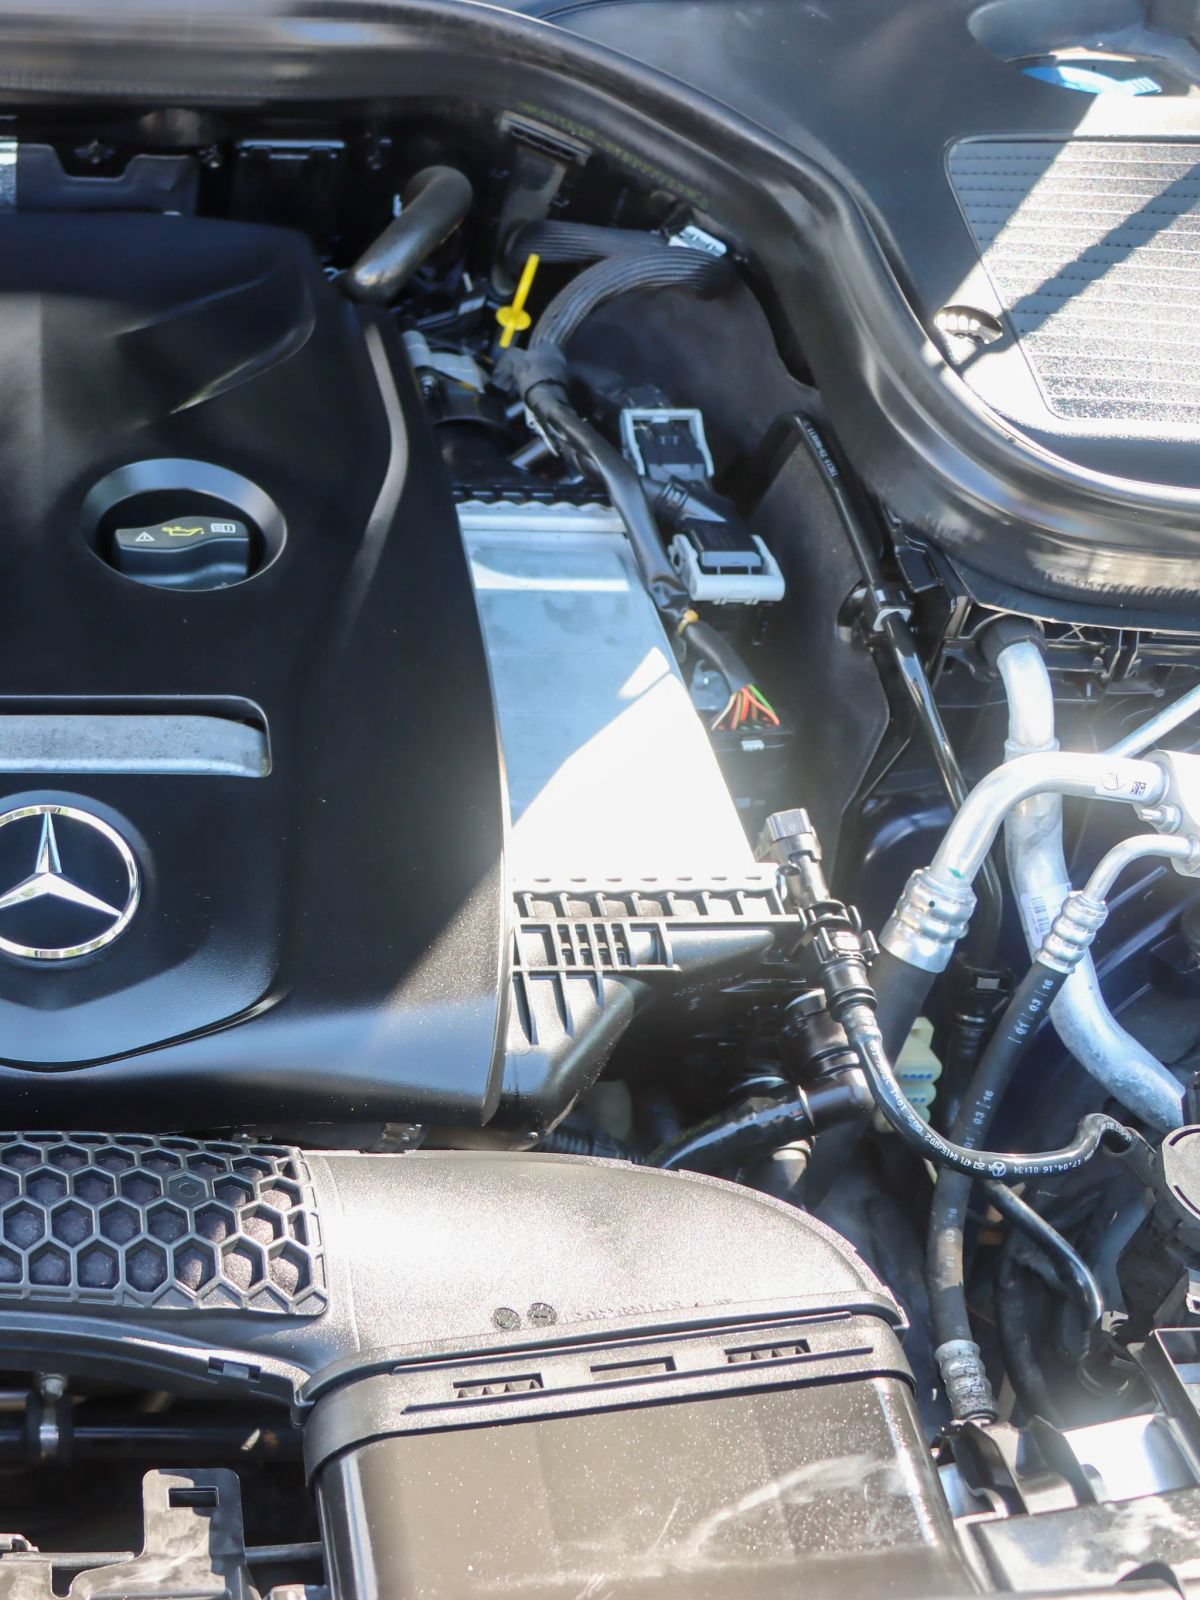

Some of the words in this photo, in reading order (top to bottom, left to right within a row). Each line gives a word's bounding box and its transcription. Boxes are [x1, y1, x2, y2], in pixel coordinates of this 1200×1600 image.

[1028, 998, 1042, 1012] 03
[1041, 978, 1055, 991] 16
[972, 1111, 986, 1125] 03
[1042, 1159, 1081, 1174] 17.04.16
